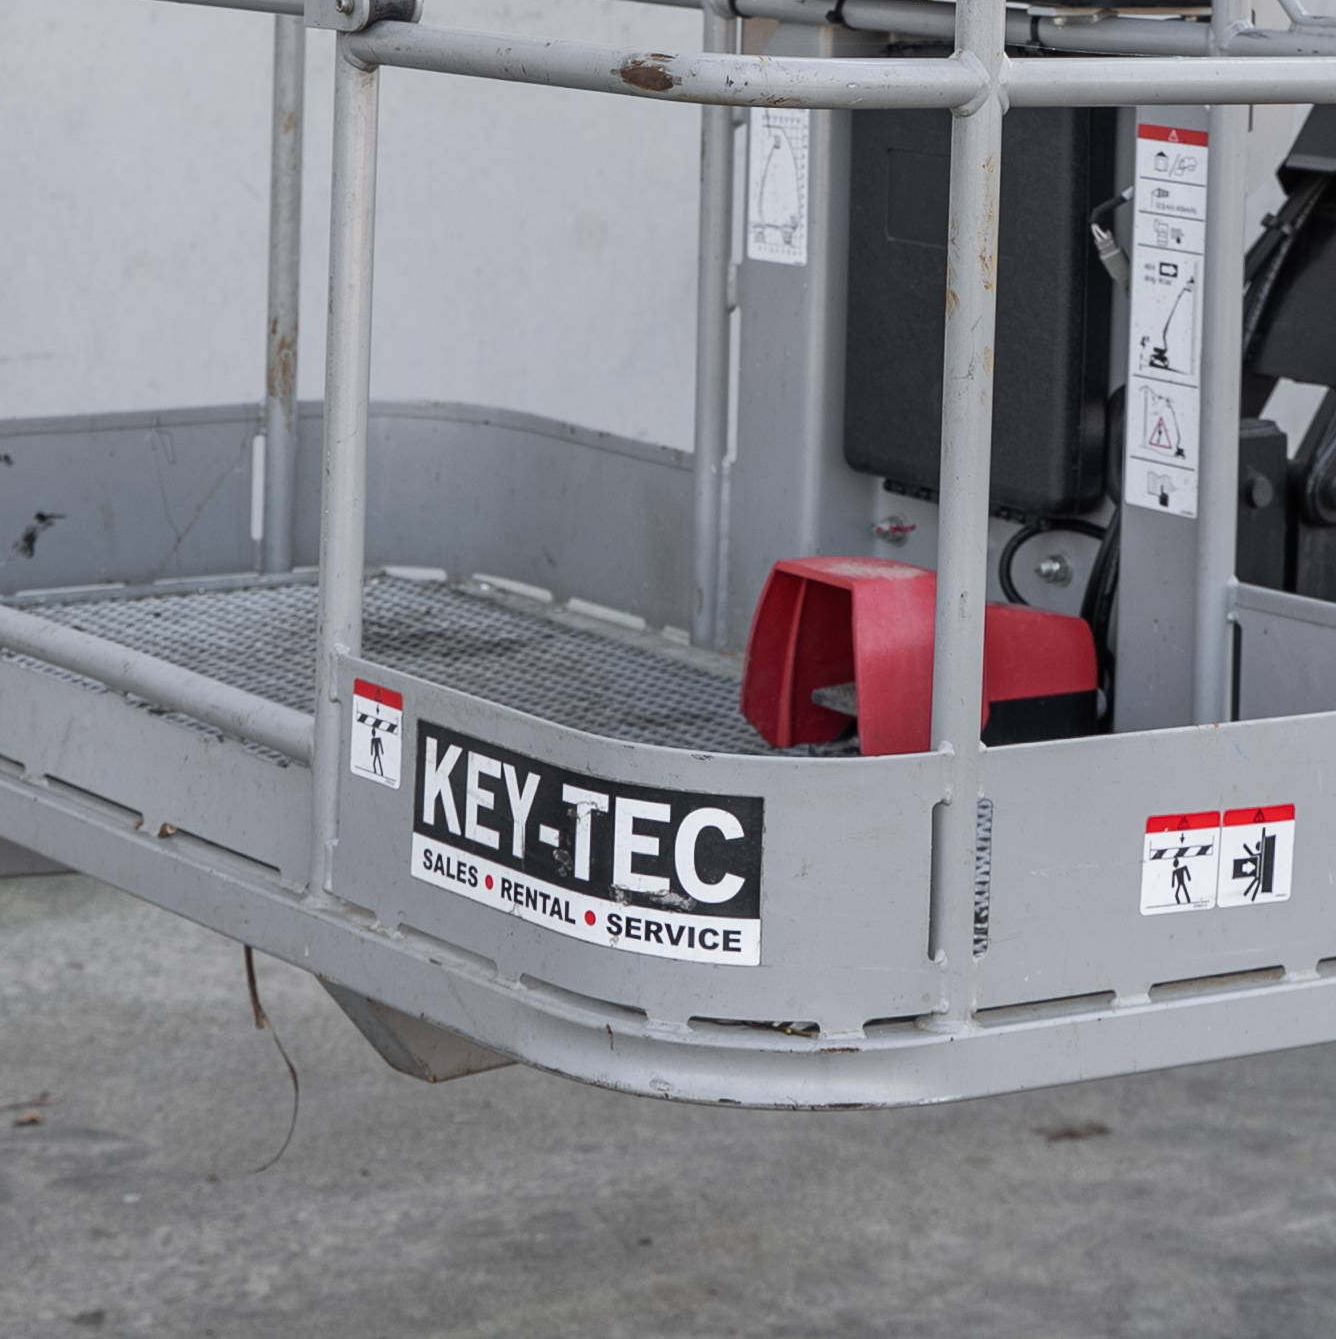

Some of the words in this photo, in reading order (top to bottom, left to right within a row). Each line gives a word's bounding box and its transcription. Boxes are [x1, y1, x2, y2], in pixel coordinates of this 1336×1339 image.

[421, 735, 747, 904] KEY-TEC
[422, 847, 479, 888] SALES
[500, 876, 576, 925] RENTAL
[606, 912, 743, 953] SERVICE
